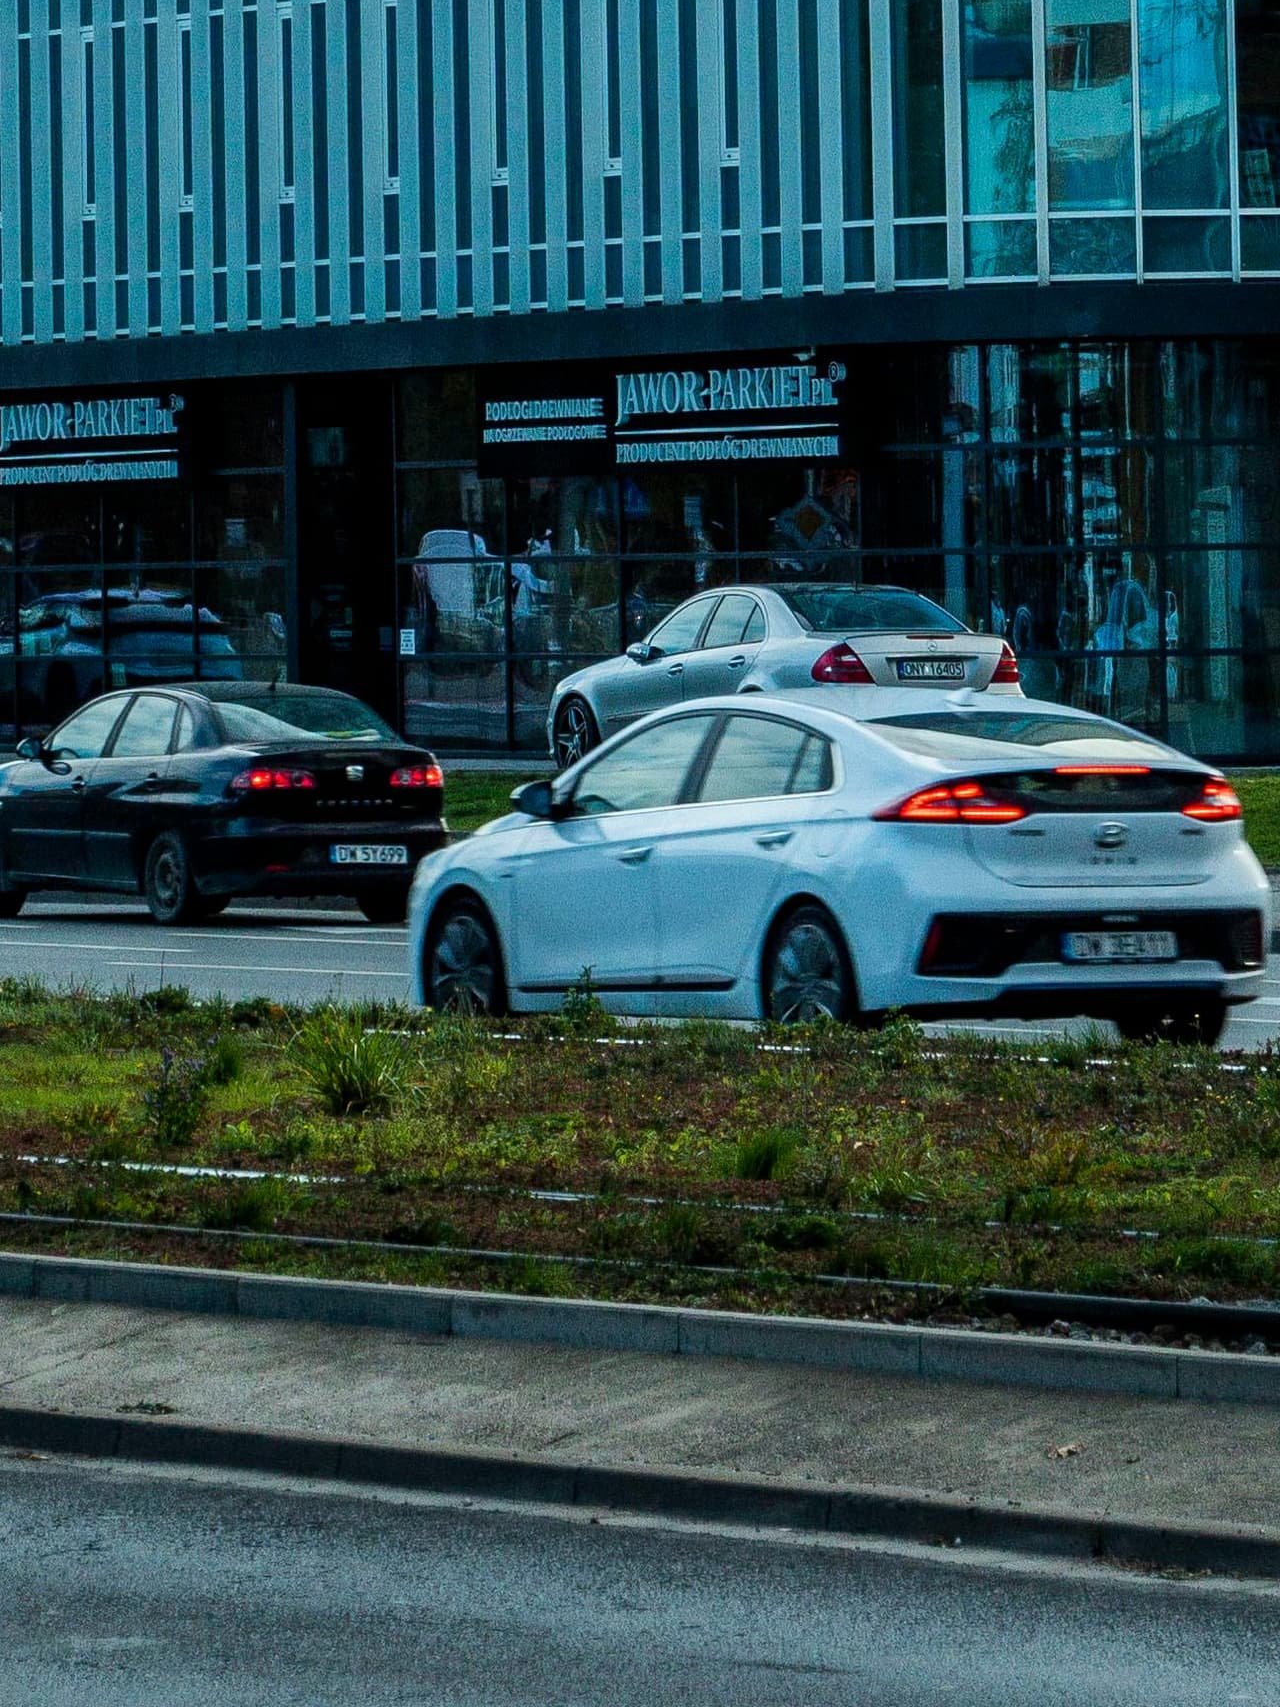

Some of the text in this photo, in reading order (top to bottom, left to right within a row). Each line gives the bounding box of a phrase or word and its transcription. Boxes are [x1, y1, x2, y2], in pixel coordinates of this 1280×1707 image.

[616, 441, 689, 463] PRODUCENT
[929, 662, 962, 675] 16405
[359, 847, 404, 862] 5Y699
